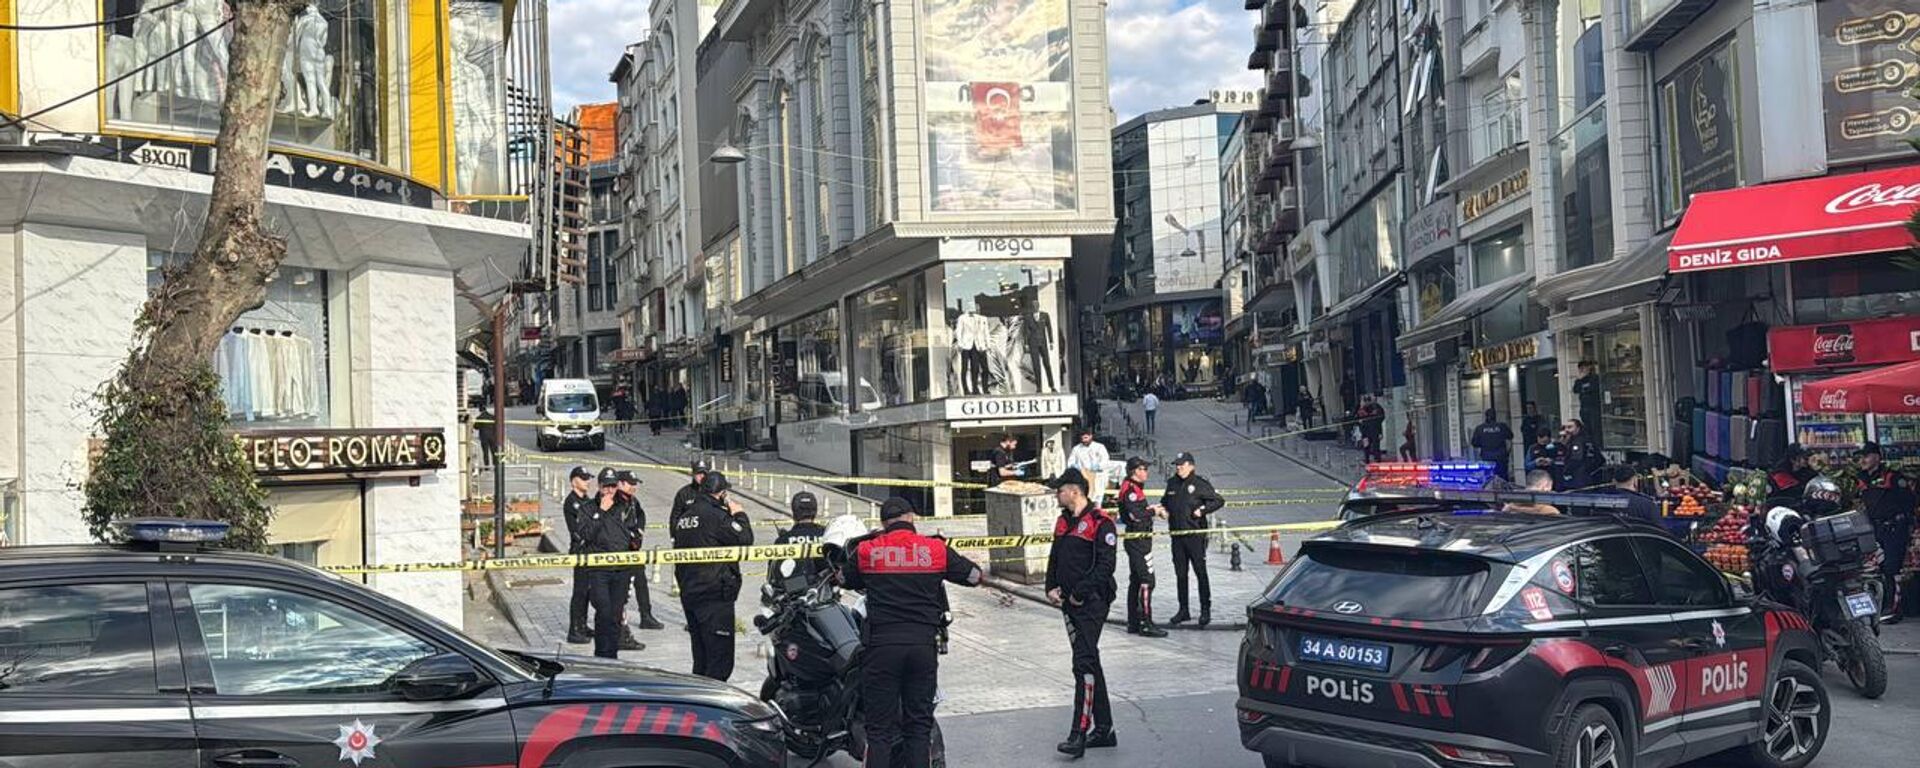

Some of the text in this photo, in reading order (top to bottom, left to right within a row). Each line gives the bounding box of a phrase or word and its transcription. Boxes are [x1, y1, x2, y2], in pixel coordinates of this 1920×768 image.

[141, 148, 188, 168] ВХОД
[978, 238, 1034, 256] mega
[1737, 245, 1782, 261] GIDA
[961, 398, 1063, 416] GIOBERTI
[329, 436, 413, 466] ROMA
[1303, 640, 1383, 664] 34 A 80153
